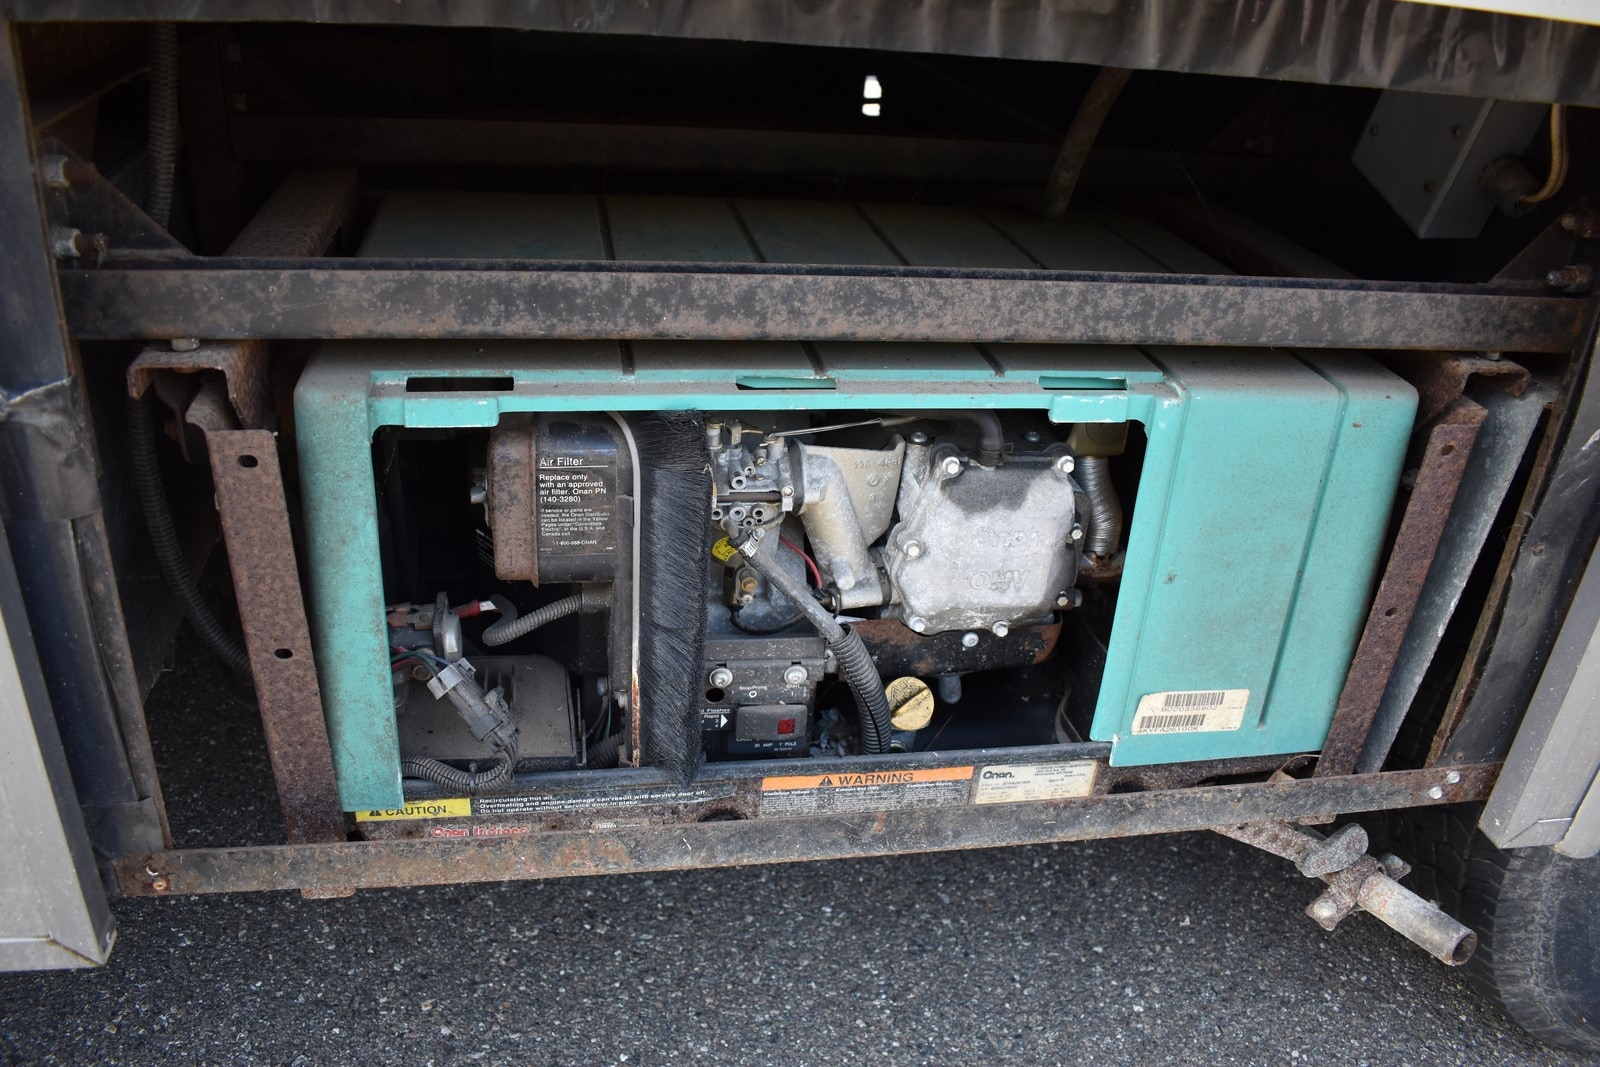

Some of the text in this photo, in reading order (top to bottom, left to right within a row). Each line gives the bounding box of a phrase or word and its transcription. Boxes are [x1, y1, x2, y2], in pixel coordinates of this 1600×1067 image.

[540, 456, 583, 466] Air Filter
[838, 772, 914, 785] WARNING
[983, 770, 1012, 780] Onan
[385, 806, 446, 816] CAUTION
